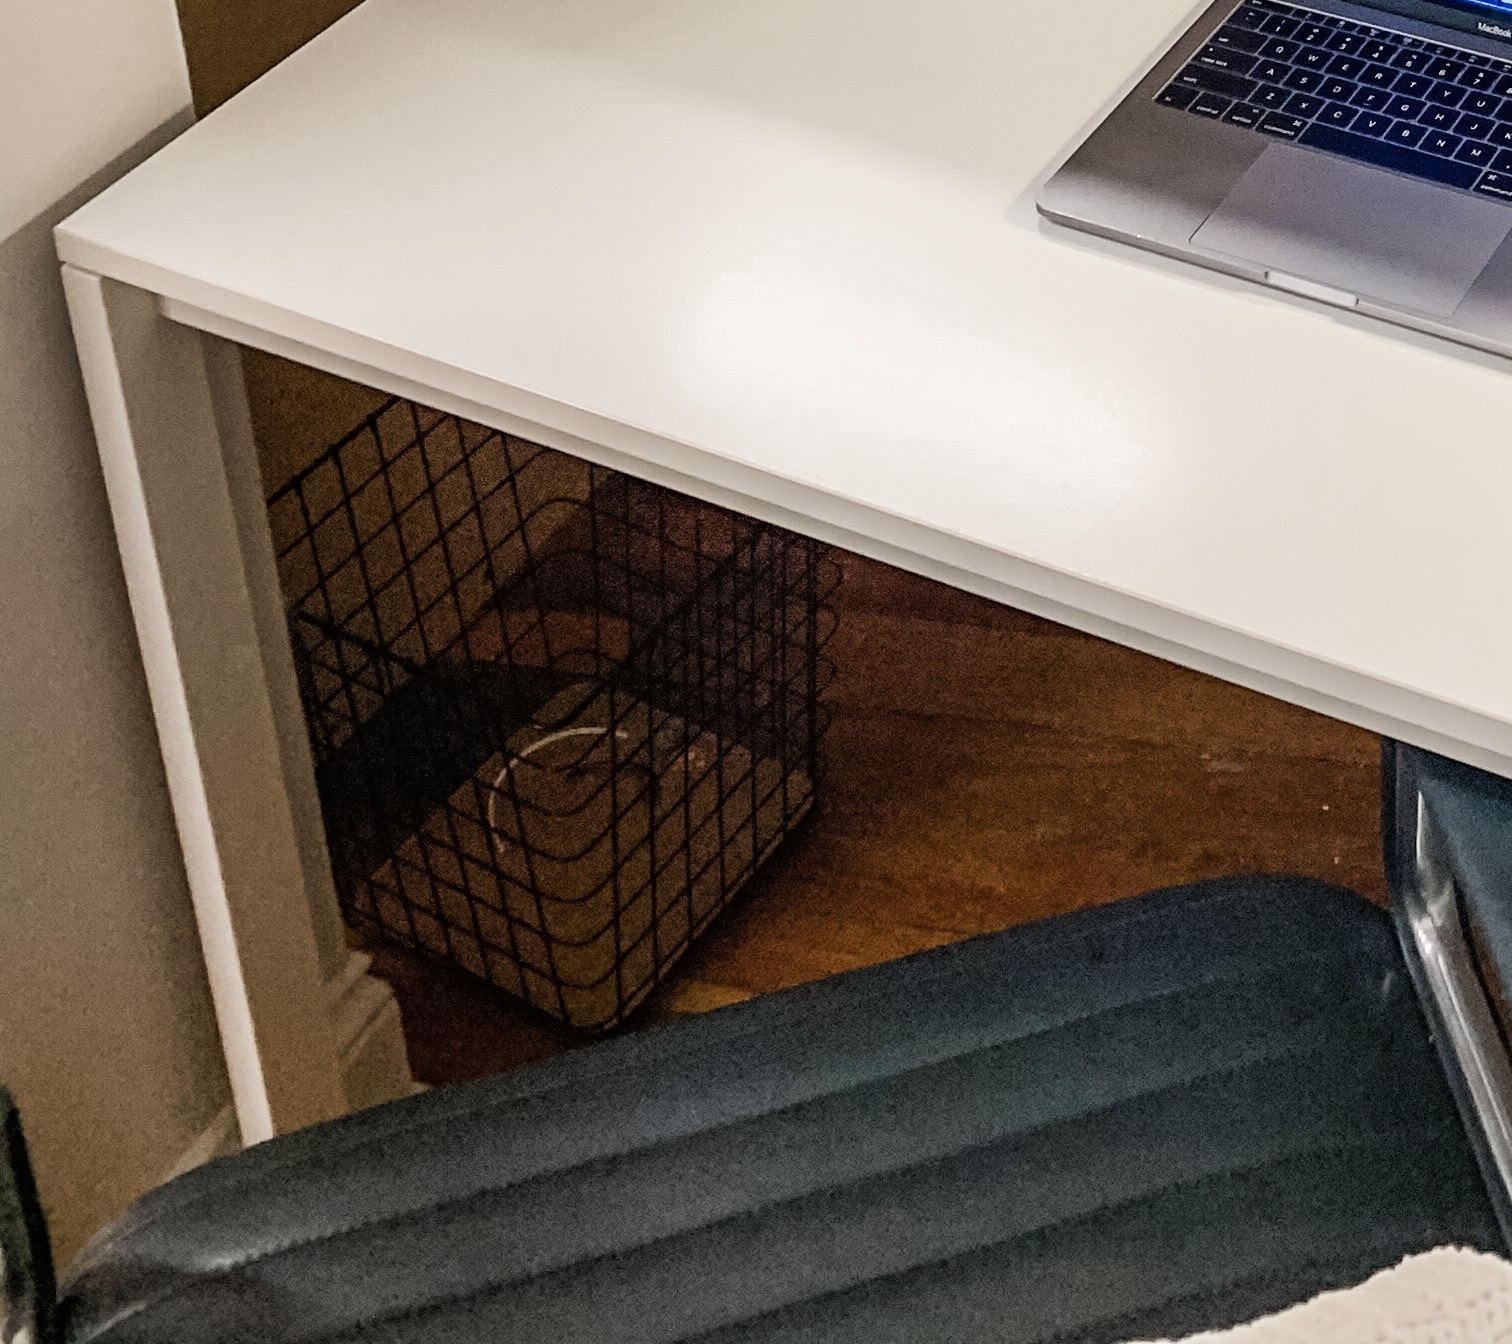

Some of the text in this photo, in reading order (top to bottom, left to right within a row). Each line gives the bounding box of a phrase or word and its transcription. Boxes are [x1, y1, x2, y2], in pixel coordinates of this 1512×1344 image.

[1477, 22, 1512, 38] MacBook
[1266, 68, 1274, 76] A
[1332, 85, 1342, 93] D
[1434, 113, 1445, 121] H
[1275, 46, 1284, 54] Q
[1308, 54, 1319, 62] W
[1341, 63, 1350, 71] E
[1374, 72, 1383, 80] R
[1476, 100, 1486, 108] U
[1265, 92, 1275, 100] Z
[1333, 110, 1343, 119] C
[1368, 120, 1377, 128] V
[1401, 129, 1410, 137] B
[1436, 139, 1446, 148] N
[1470, 148, 1482, 157] M
